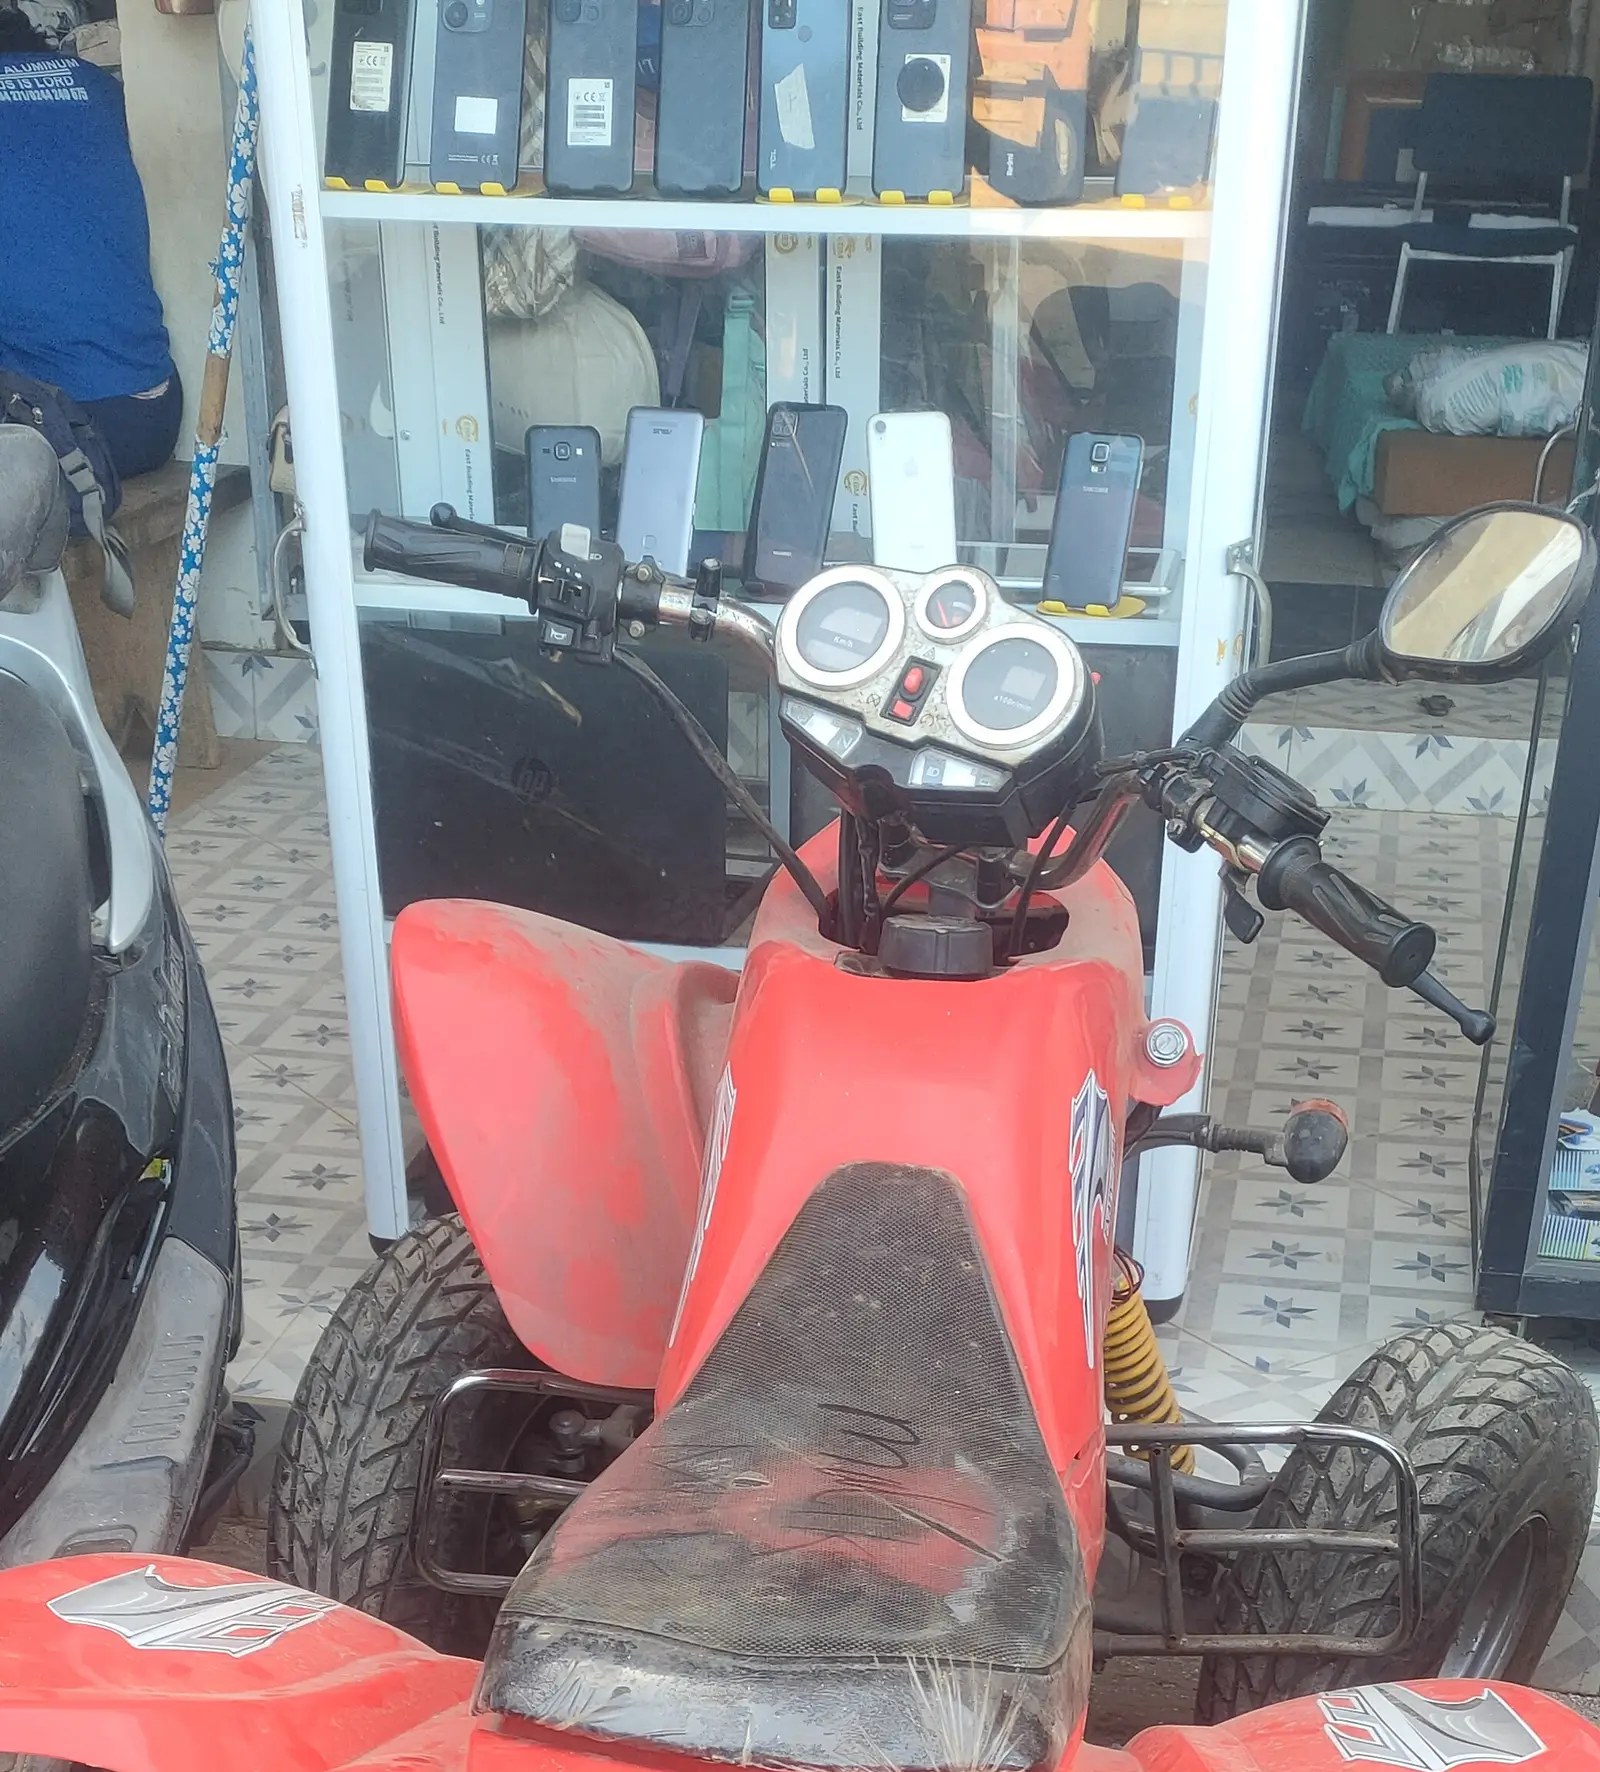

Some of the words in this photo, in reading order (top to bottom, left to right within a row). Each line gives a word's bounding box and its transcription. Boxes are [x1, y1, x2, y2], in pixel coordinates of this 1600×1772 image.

[4, 58, 80, 74] ALUMINUM
[17, 78, 33, 90] IS
[34, 75, 75, 89] LORD
[834, 284, 842, 316] Building
